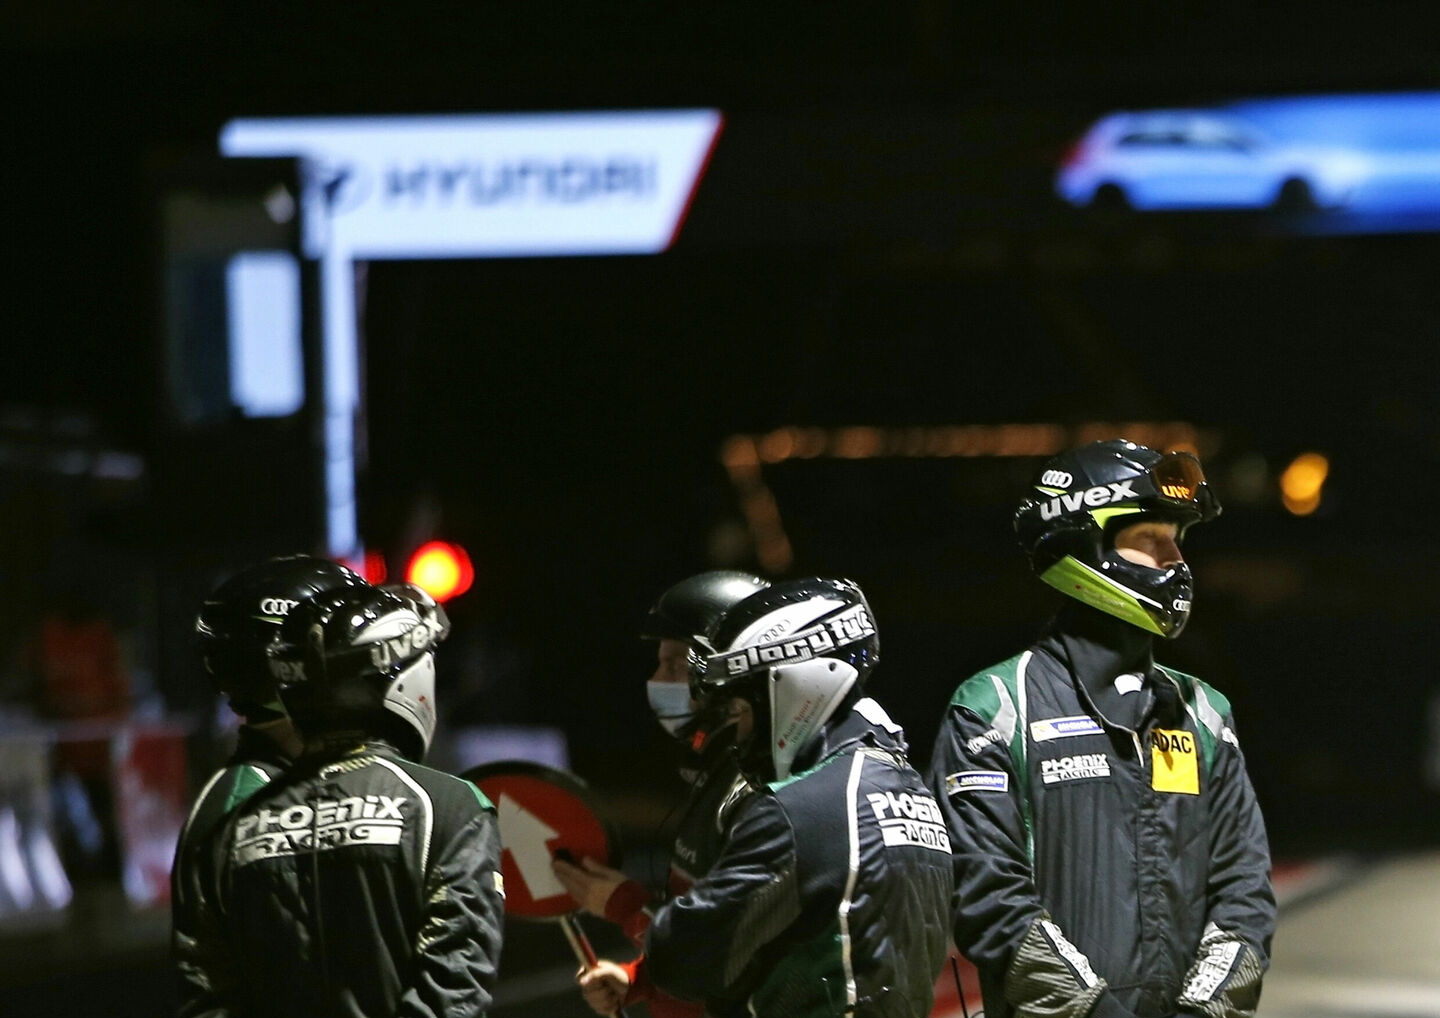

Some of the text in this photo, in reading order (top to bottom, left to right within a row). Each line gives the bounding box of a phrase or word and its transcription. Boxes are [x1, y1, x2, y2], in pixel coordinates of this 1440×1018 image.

[1040, 480, 1140, 521] uvex
[371, 610, 444, 674] uvex
[1152, 733, 1192, 755] ADAC
